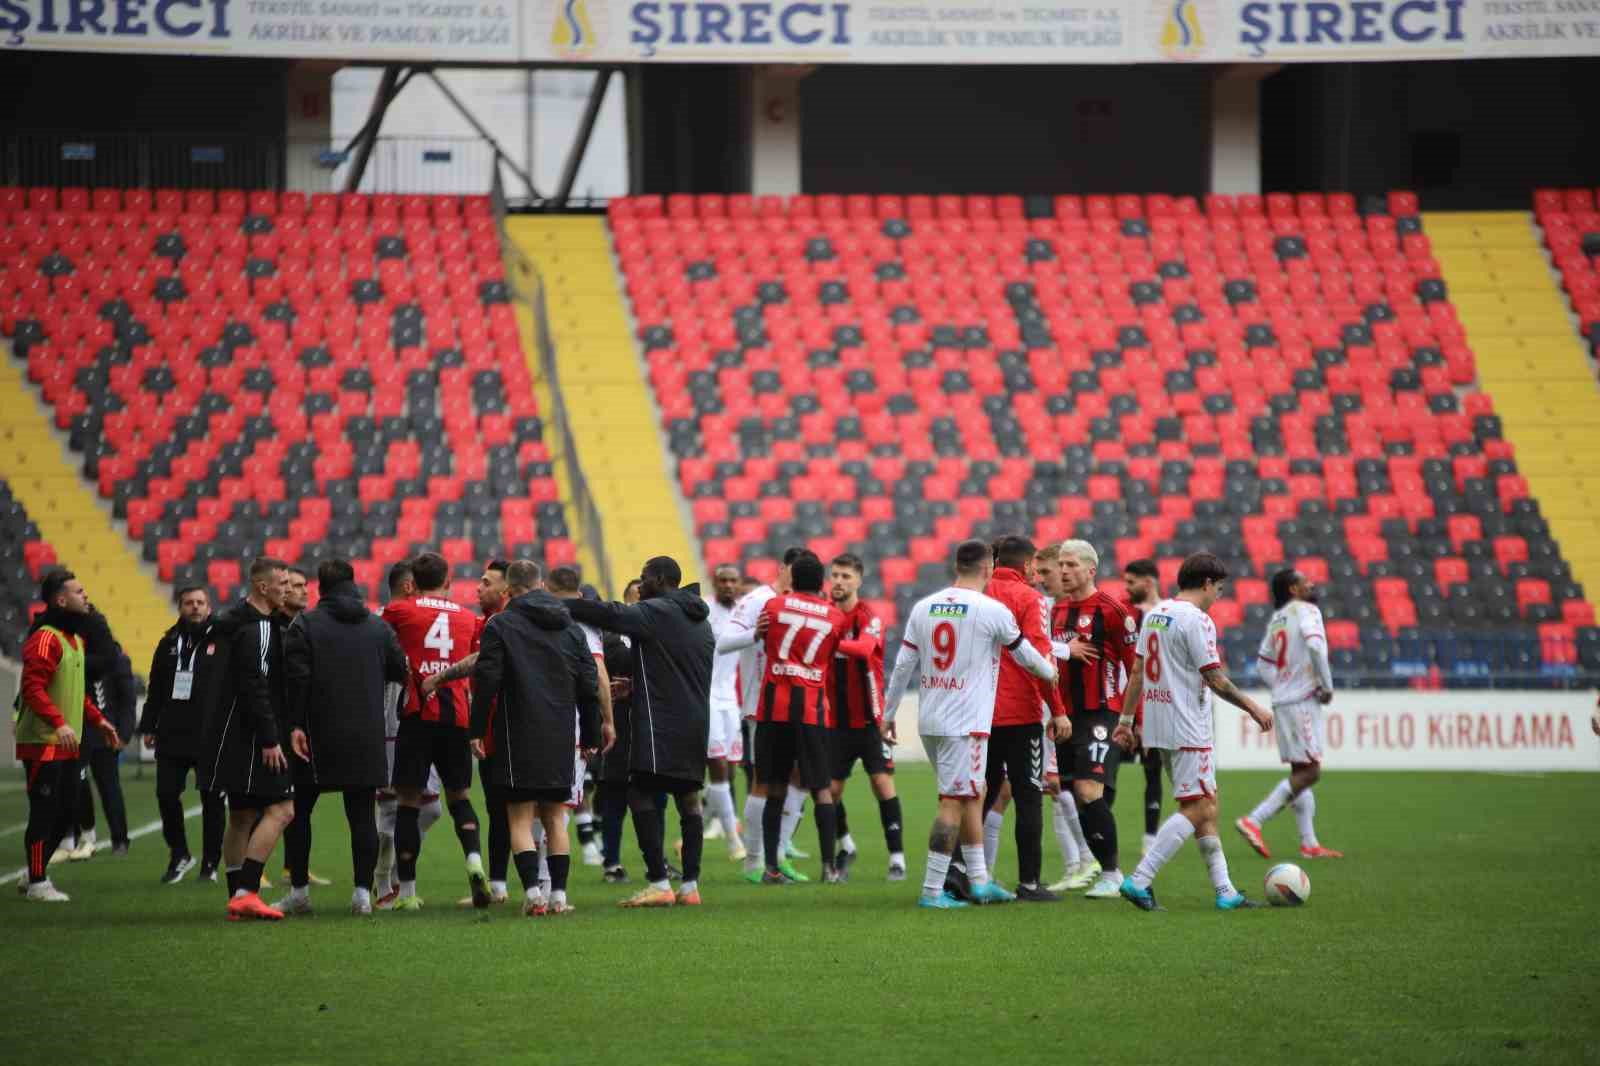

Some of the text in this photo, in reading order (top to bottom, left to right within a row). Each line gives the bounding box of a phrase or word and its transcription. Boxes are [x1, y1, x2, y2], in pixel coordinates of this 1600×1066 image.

[336, 23, 364, 42] VE
[368, 24, 440, 43] PAMUK
[934, 606, 964, 615] aksa
[423, 611, 454, 659] 4
[778, 611, 833, 665] 77
[932, 621, 956, 672] 9
[1145, 631, 1162, 683] 8
[1088, 743, 1110, 763] 17
